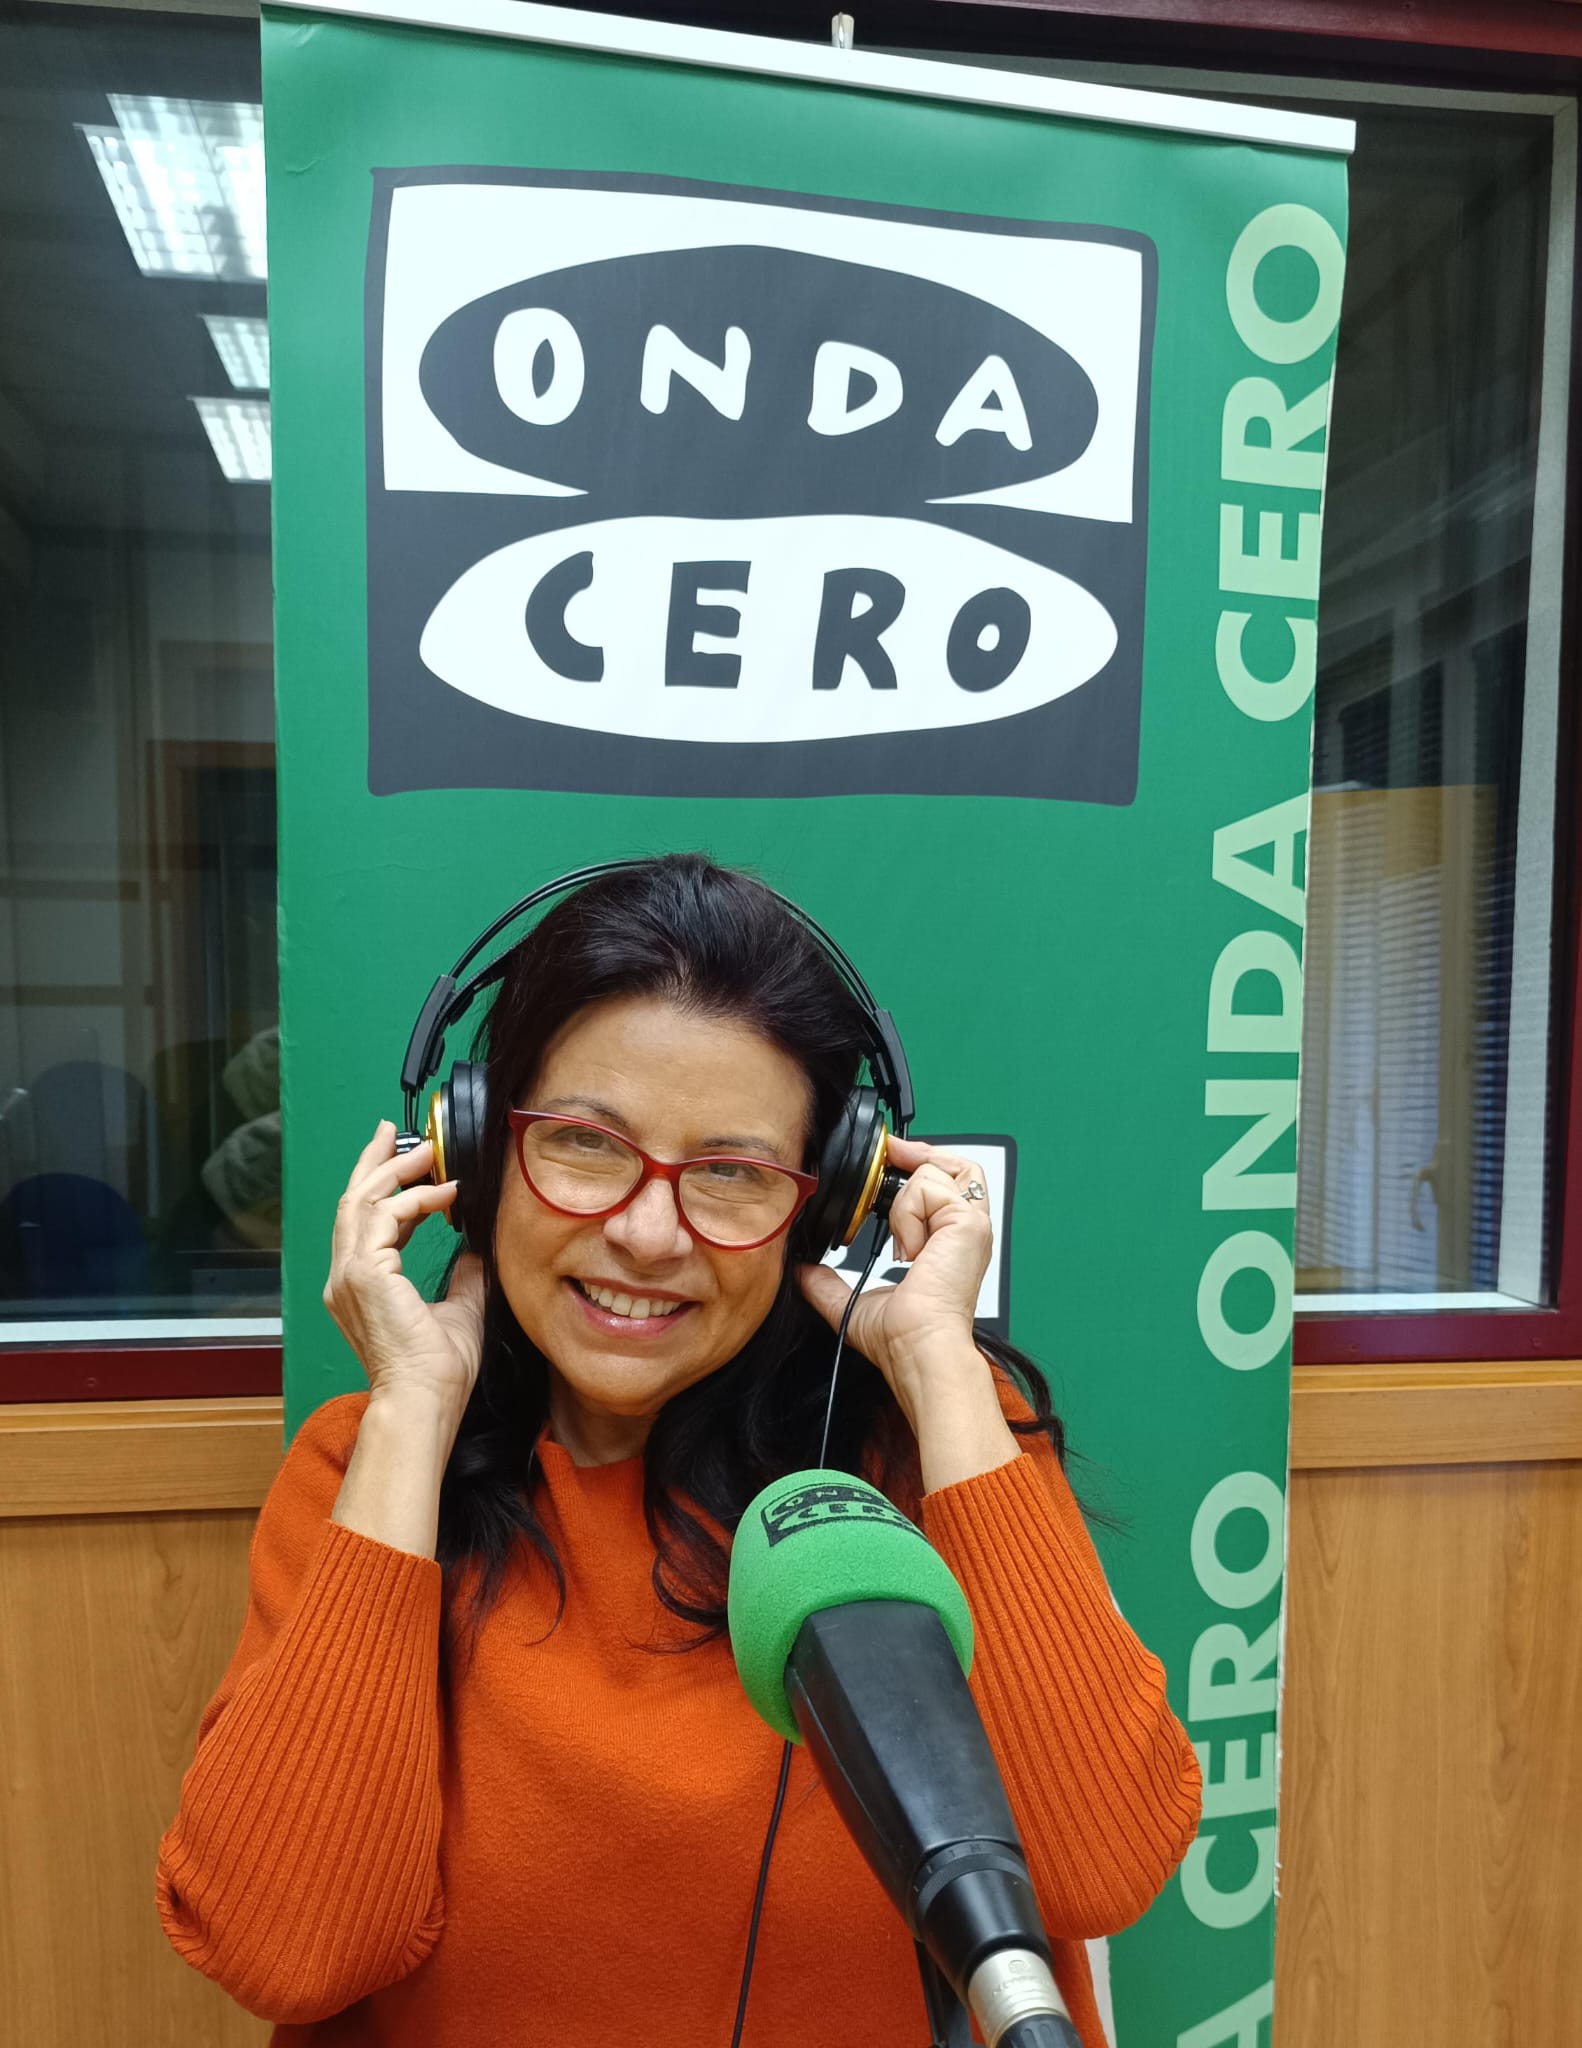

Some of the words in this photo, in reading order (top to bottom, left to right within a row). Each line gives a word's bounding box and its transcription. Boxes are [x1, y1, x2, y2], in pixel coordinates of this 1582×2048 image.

[493, 307, 1033, 451] ONDA
[1215, 203, 1346, 722] CERO
[525, 550, 1031, 693] CERO
[1197, 791, 1309, 1371] ONDA
[1180, 1471, 1285, 1929] CERO
